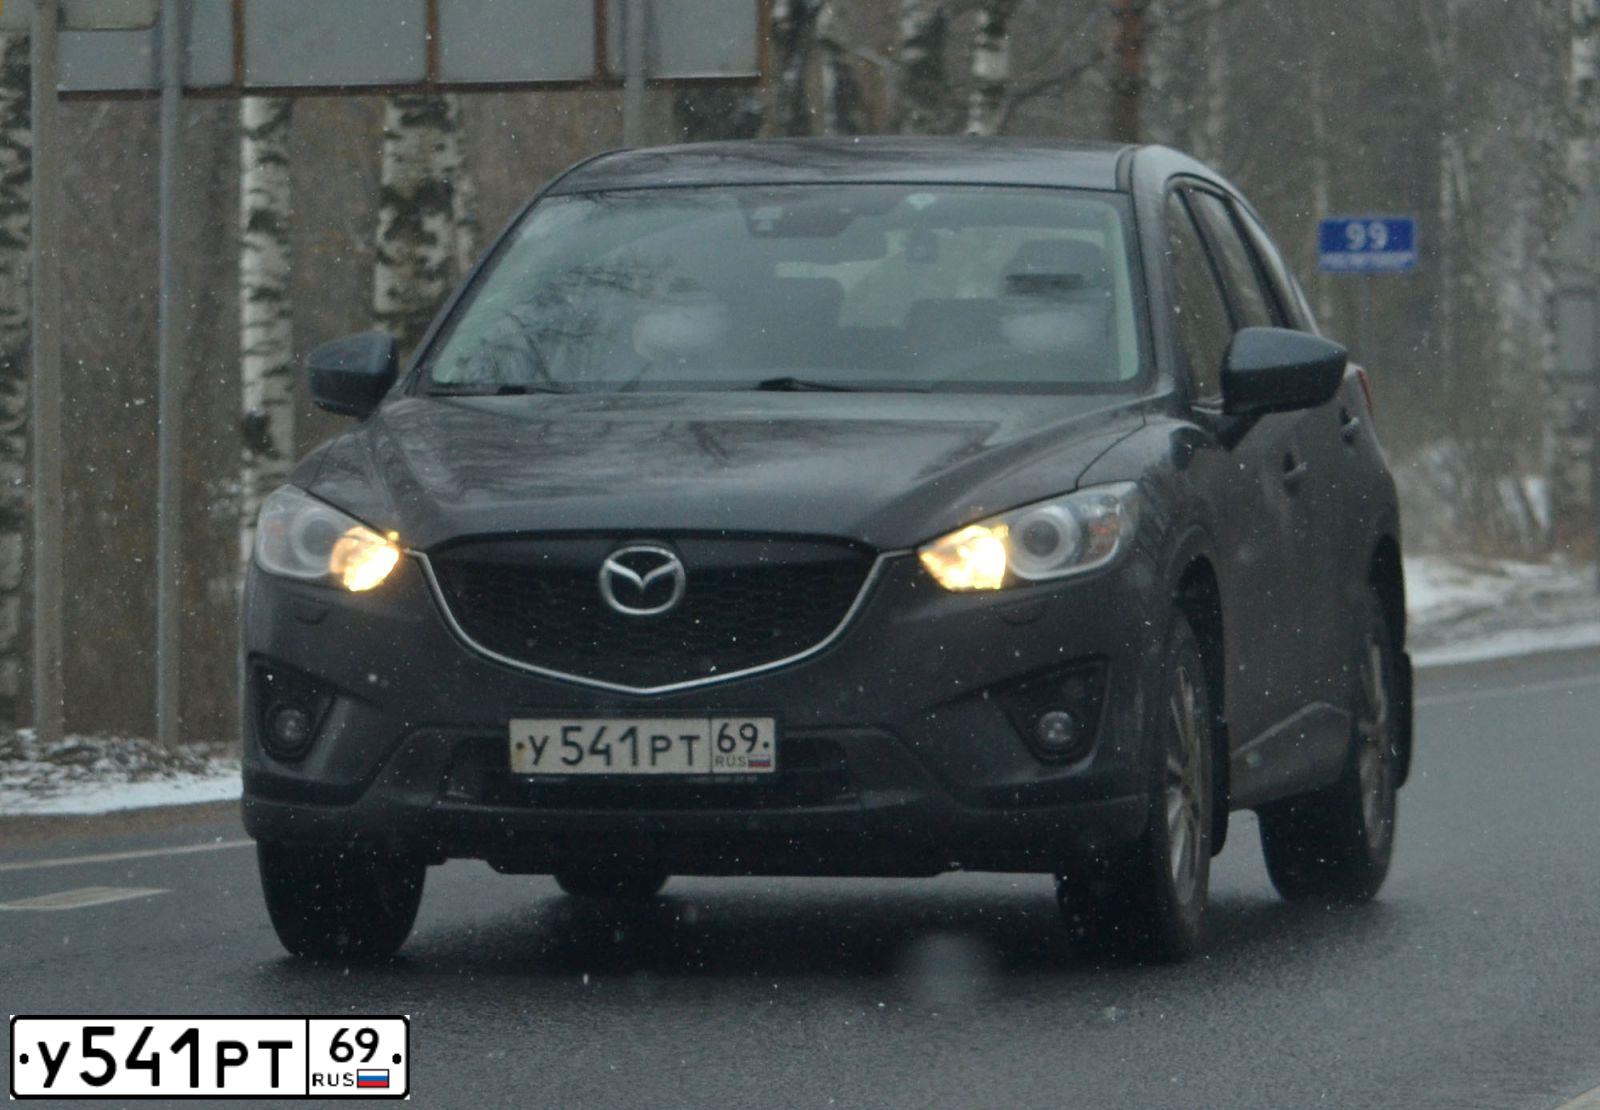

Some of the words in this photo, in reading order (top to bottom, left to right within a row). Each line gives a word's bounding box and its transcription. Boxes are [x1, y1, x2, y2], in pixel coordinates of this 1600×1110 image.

[1344, 221, 1388, 251] 99
[716, 722, 759, 754] 69
[714, 755, 747, 768] RUS
